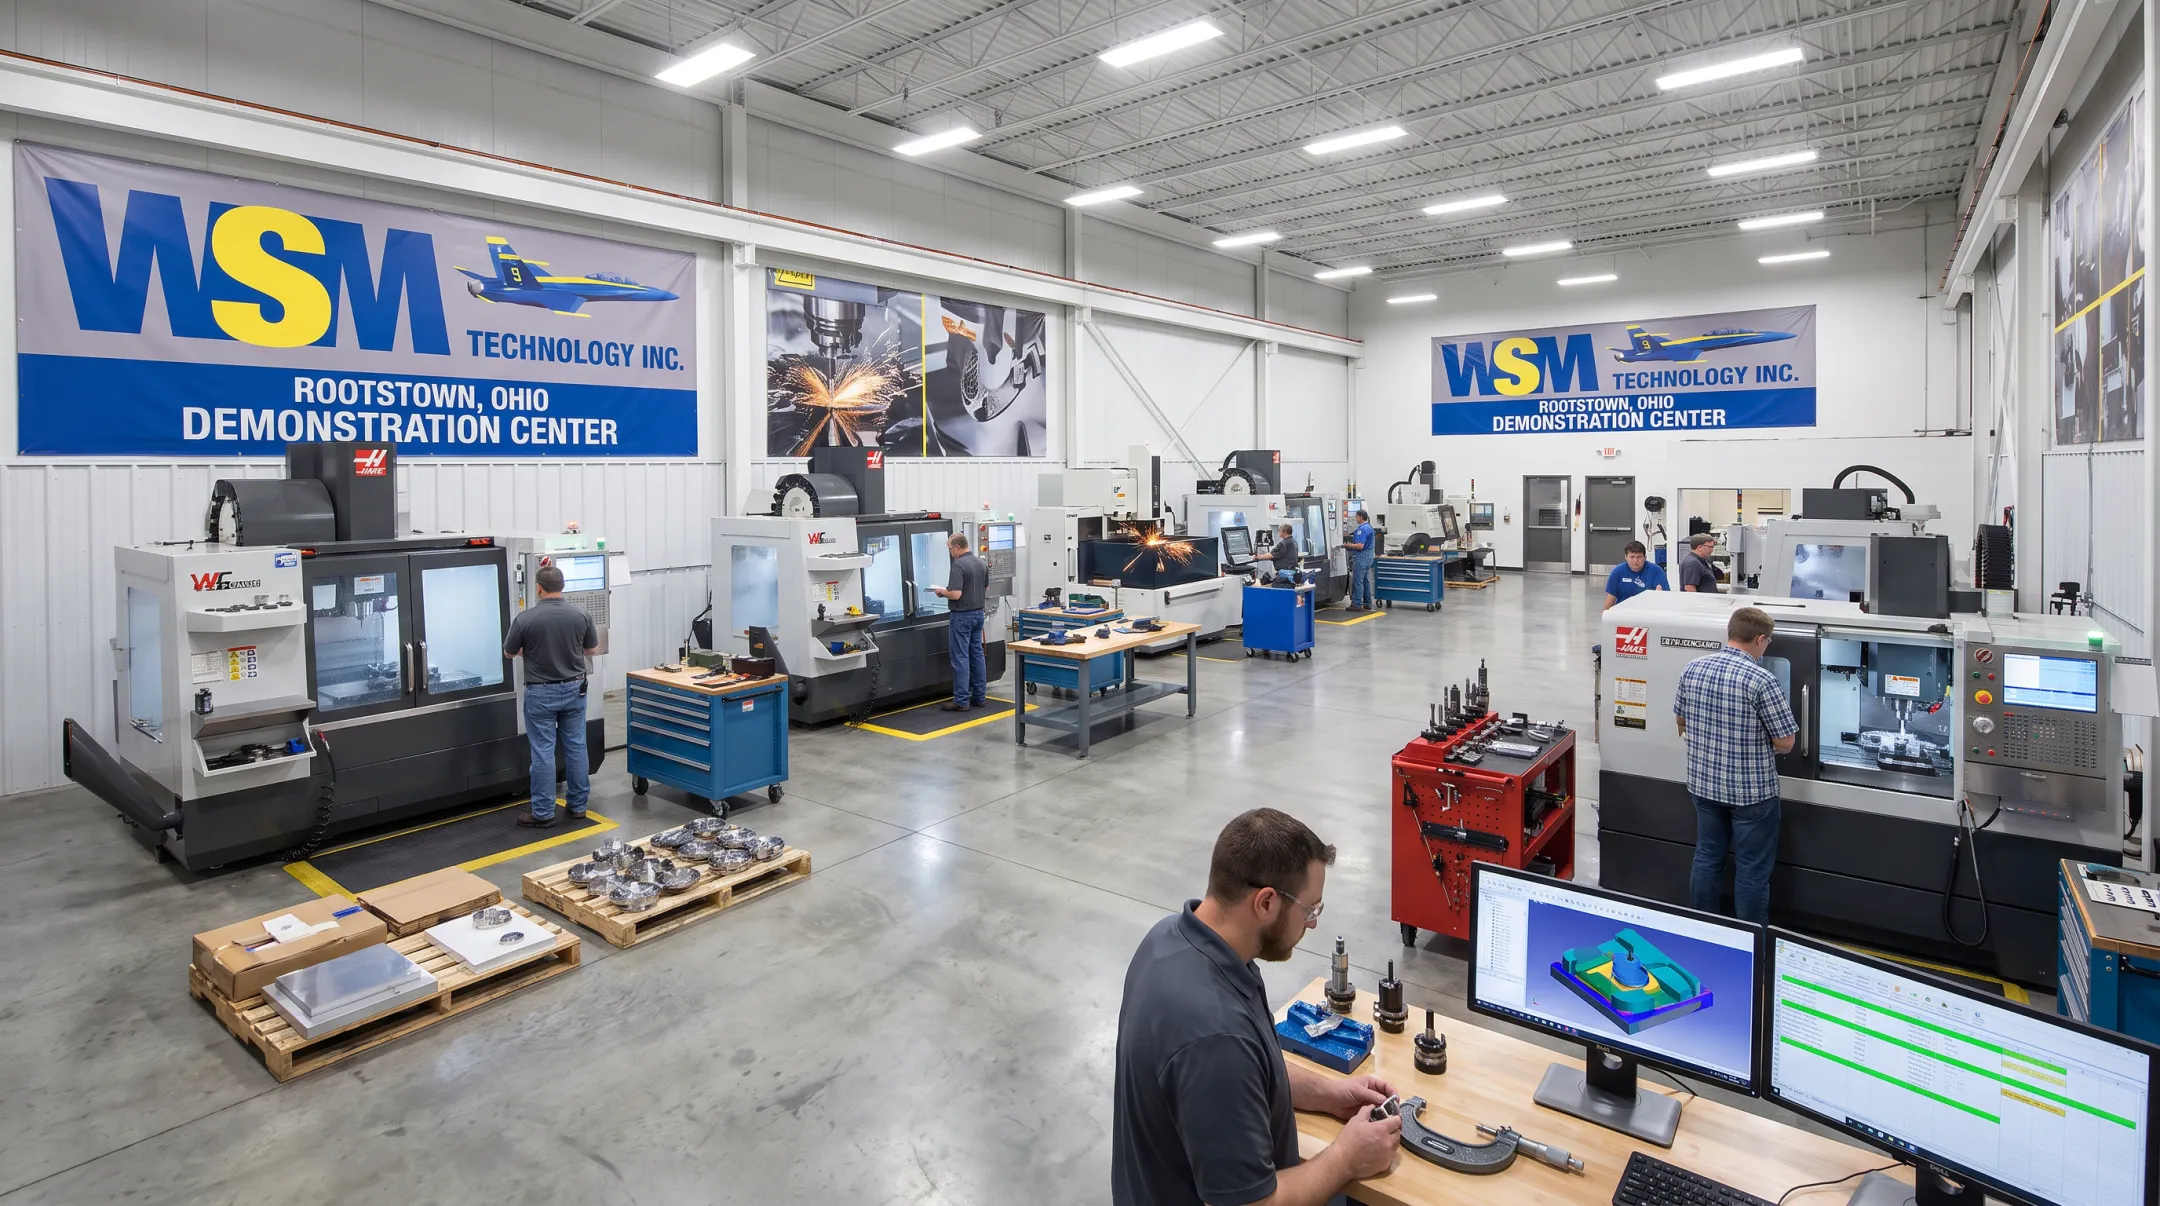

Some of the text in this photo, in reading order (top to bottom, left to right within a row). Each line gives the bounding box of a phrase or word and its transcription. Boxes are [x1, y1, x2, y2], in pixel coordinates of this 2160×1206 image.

[44, 176, 451, 356] WSM
[510, 267, 522, 282] 9
[466, 329, 685, 371] TECHNOLOGY INC.
[1441, 333, 1600, 397] WSM
[294, 376, 549, 414] ROOTSTOWN, OHIO
[1612, 363, 1799, 390] TECHNOLOGY INC.
[1492, 408, 1727, 432] DEMONSTRATION CENTER
[1539, 395, 1675, 414] ROOTSTOWN, OHIO
[182, 406, 618, 446] DEMONSTRATION CENTER
